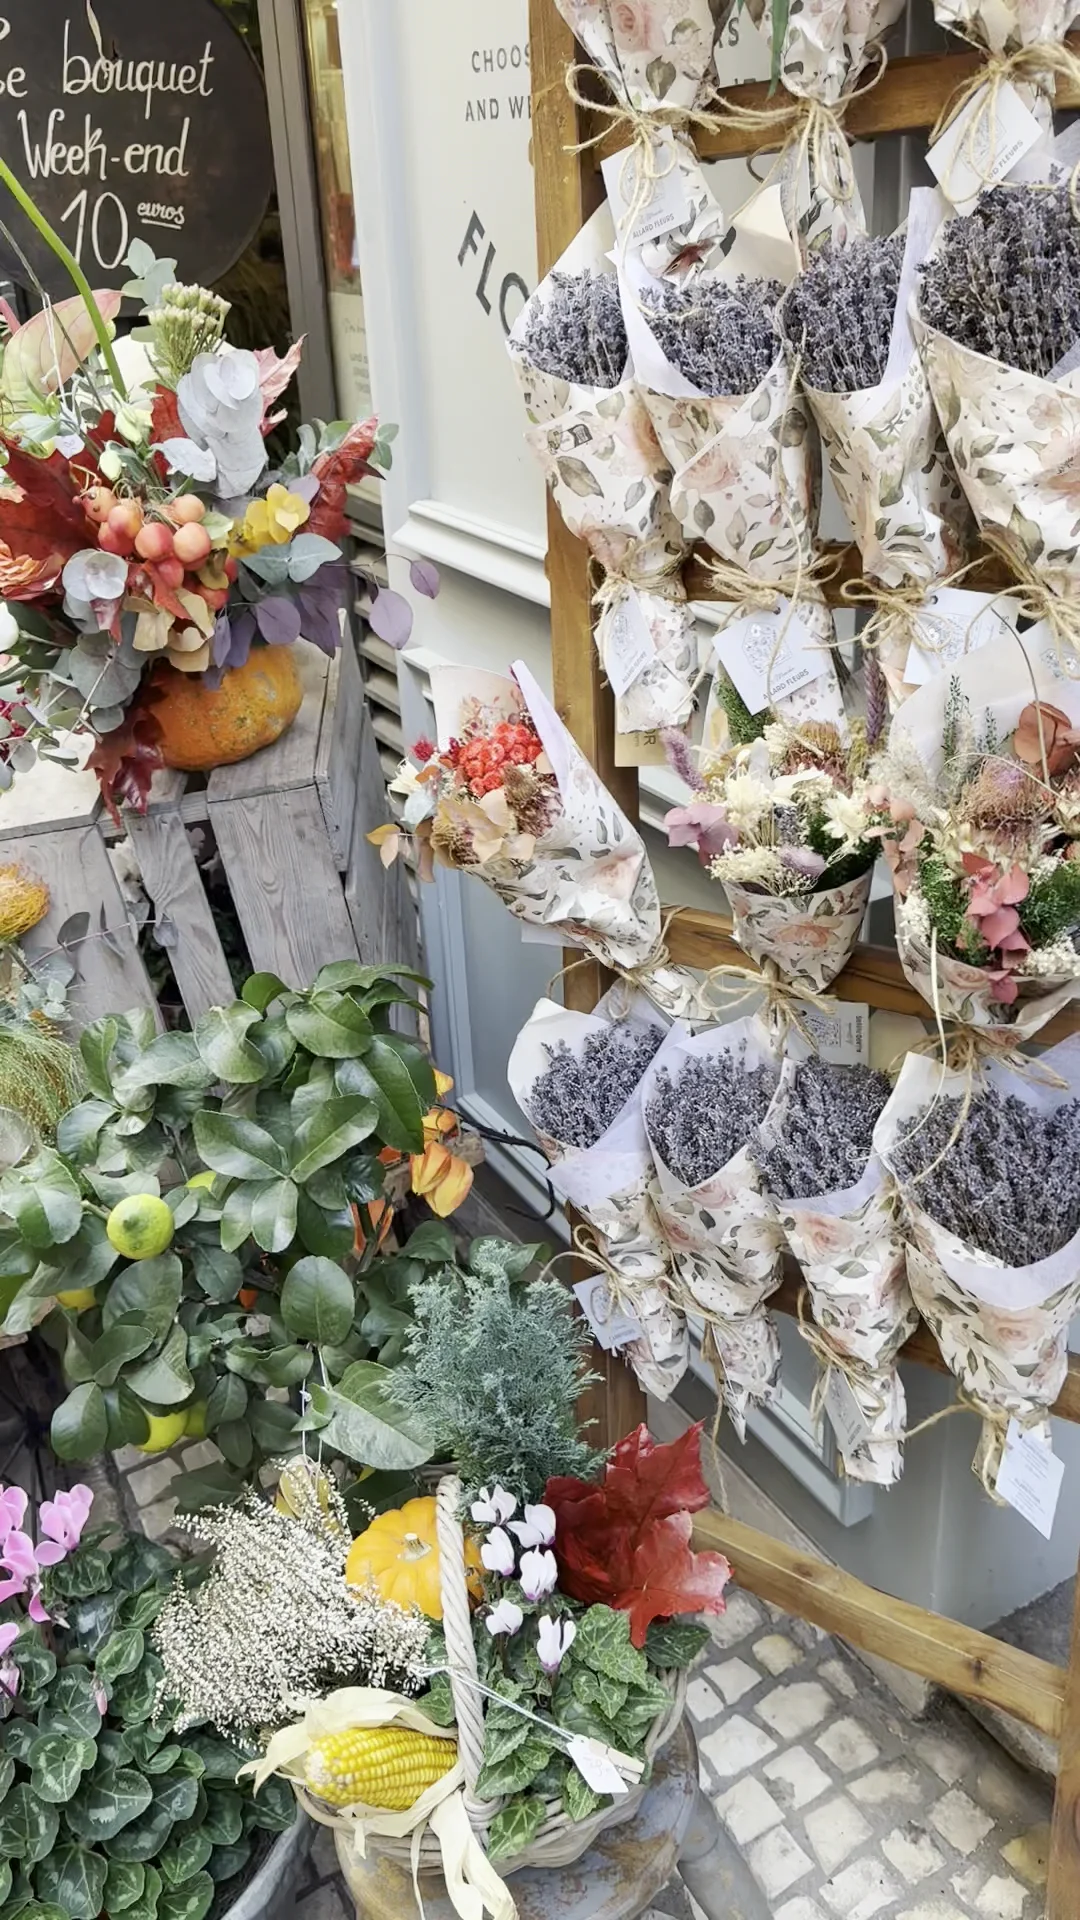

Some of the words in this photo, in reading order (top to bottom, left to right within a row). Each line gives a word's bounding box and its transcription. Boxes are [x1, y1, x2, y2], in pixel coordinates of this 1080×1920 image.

[63, 18, 215, 120] bouquet
[17, 108, 190, 181] Week-end
[465, 97, 500, 122] AND
[60, 188, 129, 270] 10
[136, 202, 185, 225] euros
[786, 668, 810, 686] FLEURS
